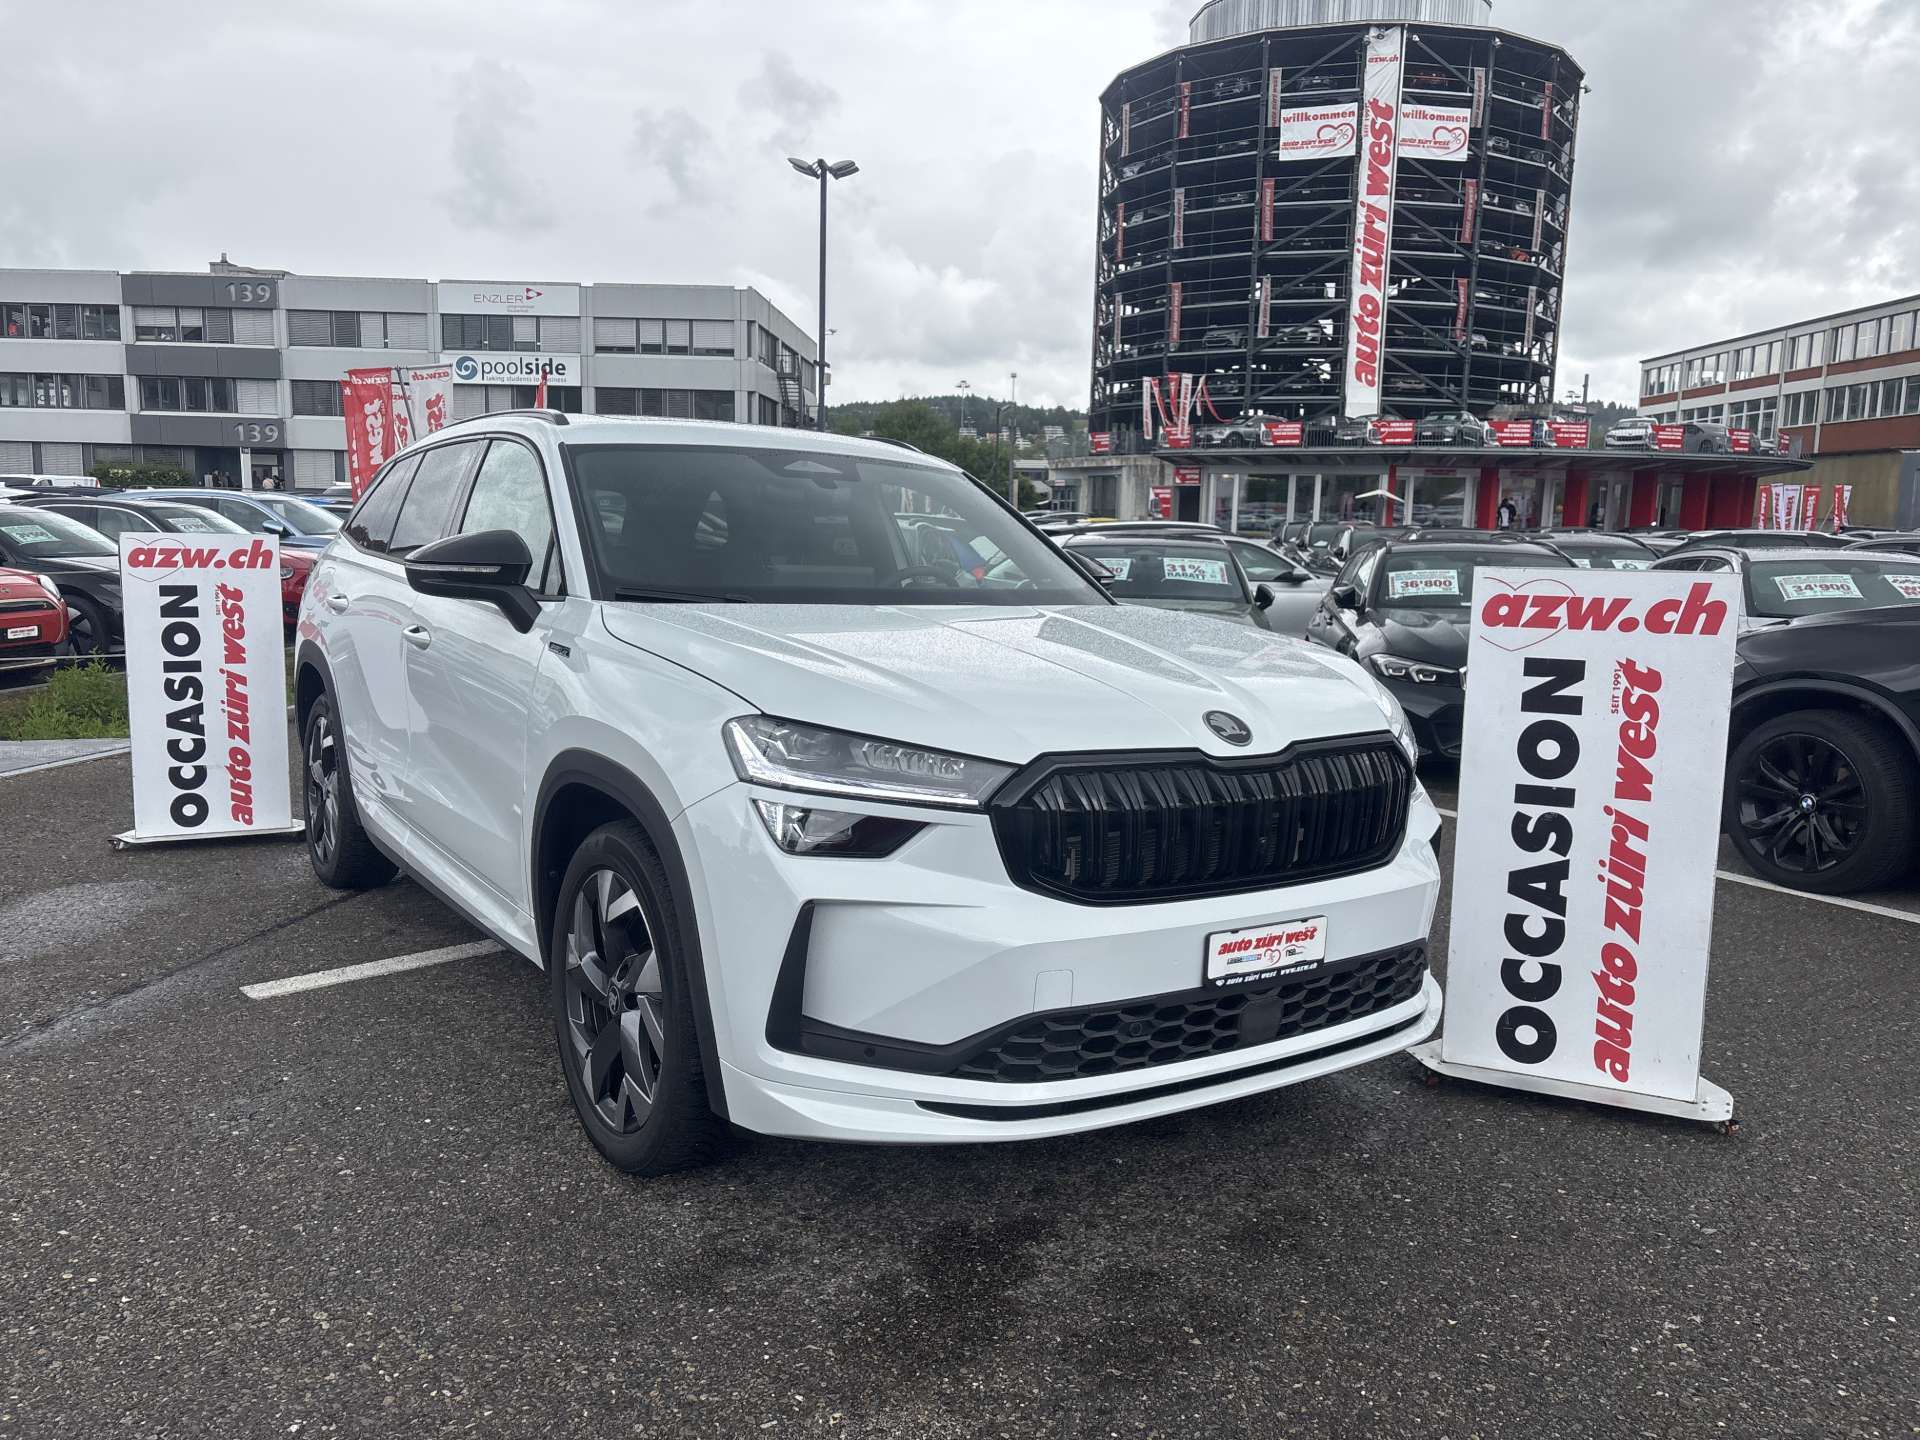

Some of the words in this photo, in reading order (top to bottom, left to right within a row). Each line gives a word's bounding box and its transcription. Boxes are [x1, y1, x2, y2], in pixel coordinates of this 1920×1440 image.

[1368, 54, 1399, 64] azw.ch
[1283, 110, 1356, 124] willkommen
[1402, 110, 1469, 123] willkommen
[1366, 98, 1394, 195] west
[1356, 200, 1388, 293] züri
[225, 282, 271, 303] 139
[473, 293, 524, 304] ENZLER
[1353, 293, 1381, 388] auto
[481, 356, 567, 381] poolside
[233, 422, 279, 443] 139
[127, 539, 274, 570] azw.ch
[1166, 563, 1206, 576] 31%
[1167, 571, 1206, 580] RABATT
[1400, 580, 1453, 589] 36'800
[1792, 583, 1850, 593] 34'900
[1481, 582, 1728, 636] azw.ch
[216, 582, 247, 665] west
[1613, 668, 1622, 691] 1991
[158, 584, 210, 828] OCCASION
[219, 668, 250, 745] züri
[1611, 694, 1620, 715] SEIT
[1614, 656, 1663, 803] west
[224, 745, 254, 826] auto
[1495, 656, 1587, 1065] OCCASION
[1597, 804, 1650, 946] züri
[1218, 938, 1253, 956] auto
[1253, 931, 1285, 950] züri
[1285, 926, 1318, 944] west
[1226, 976, 1243, 985] auto
[1261, 970, 1278, 979] west
[1590, 942, 1638, 1084] auto
